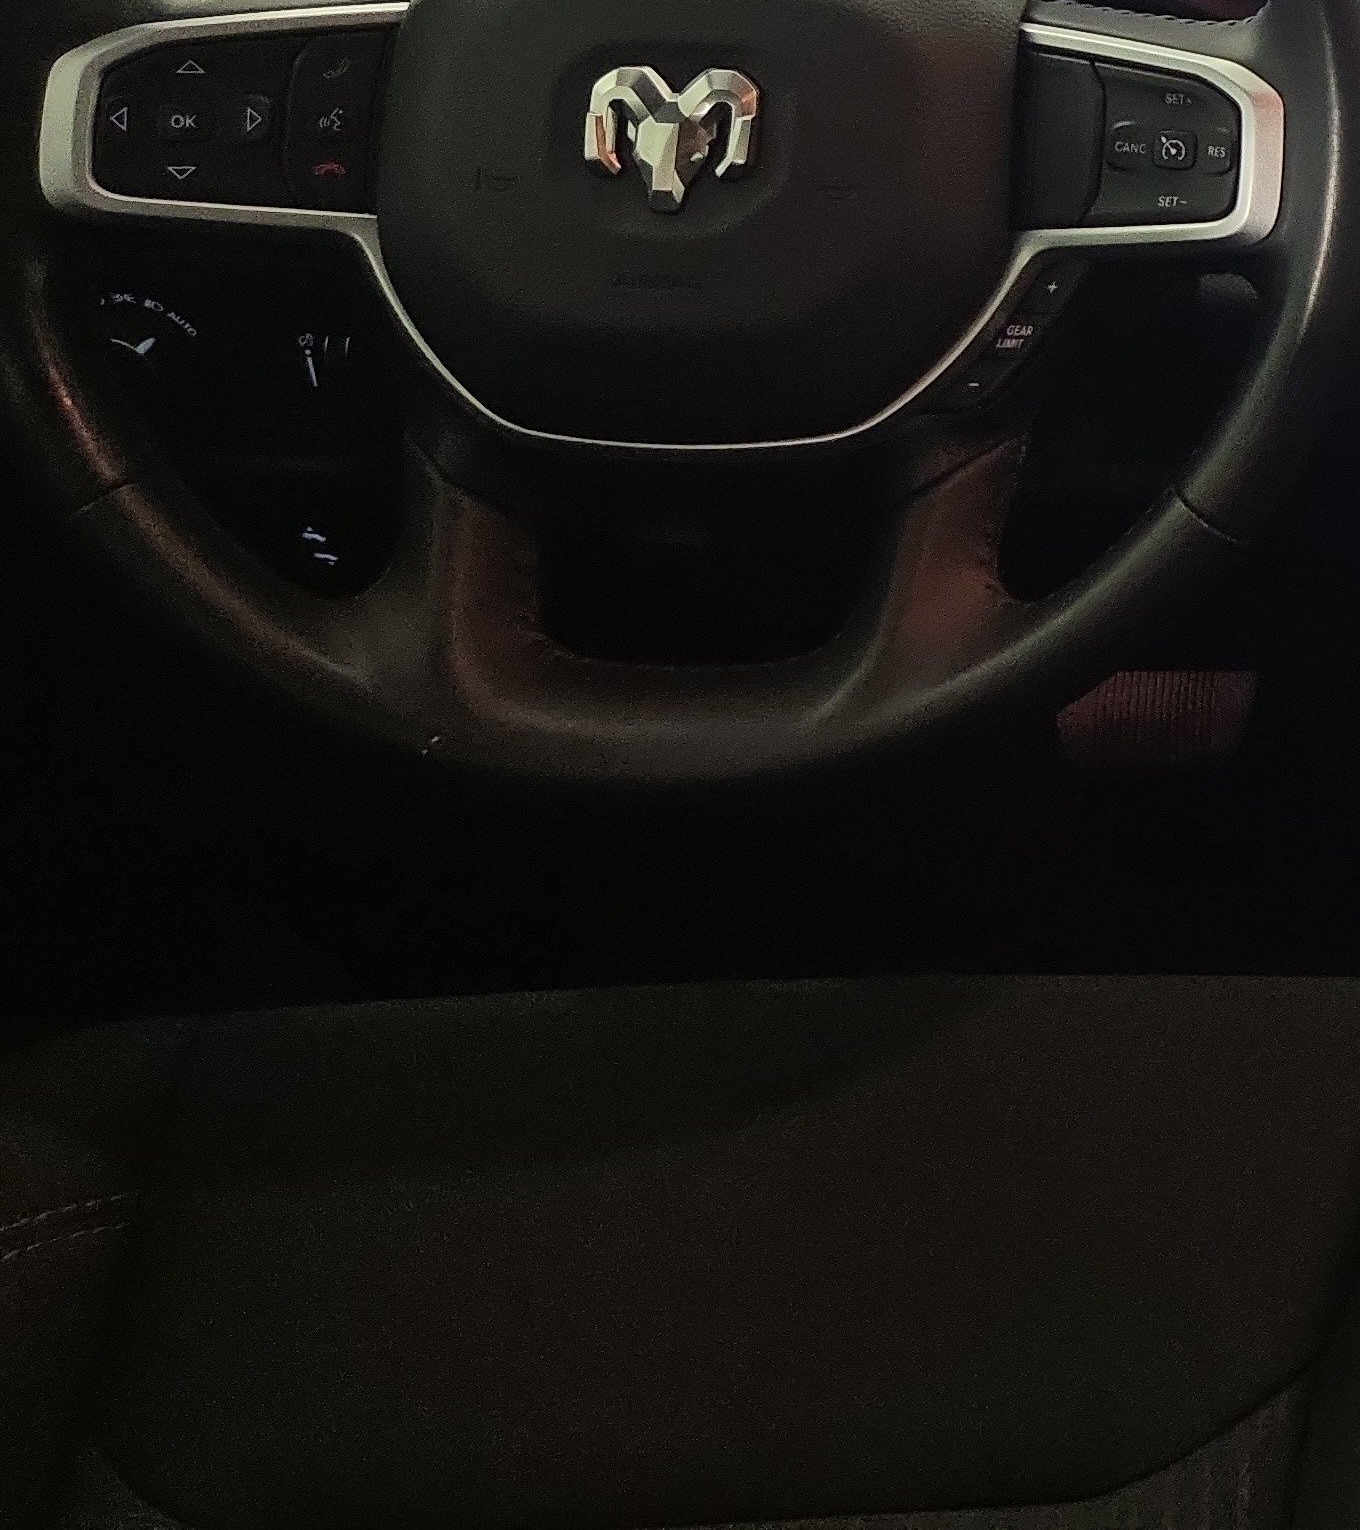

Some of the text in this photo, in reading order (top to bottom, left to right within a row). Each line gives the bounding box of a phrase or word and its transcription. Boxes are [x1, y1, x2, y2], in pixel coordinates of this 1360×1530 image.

[170, 113, 197, 129] OK
[1114, 140, 1147, 154] CANC
[1207, 145, 1226, 158] RES
[1006, 324, 1034, 337] GEAR
